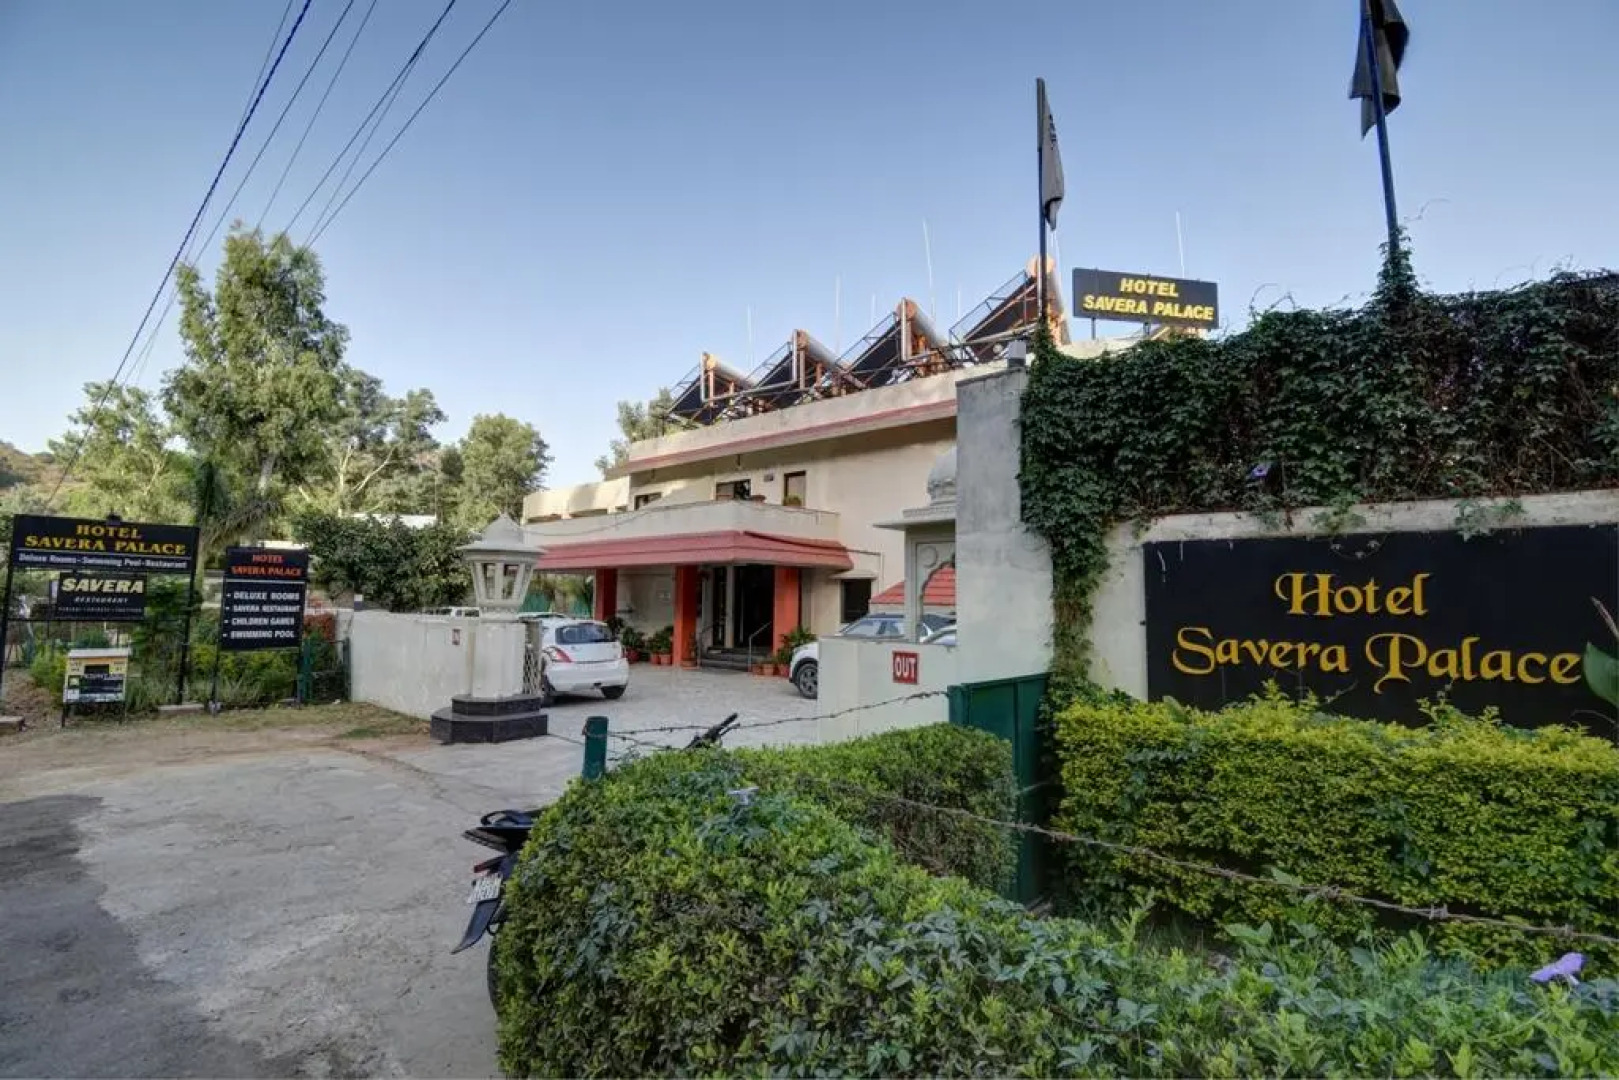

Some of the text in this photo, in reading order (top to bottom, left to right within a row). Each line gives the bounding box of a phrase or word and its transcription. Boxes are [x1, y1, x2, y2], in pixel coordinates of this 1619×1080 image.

[1120, 278, 1179, 297] HOTEL
[1083, 294, 1214, 320] SAVERA PALACE
[76, 524, 142, 539] HOTEL
[24, 535, 186, 556] SAVERA PALACE
[252, 554, 284, 564] HOTEL
[267, 567, 302, 577] PALACE
[62, 578, 144, 594] SAVERA
[233, 591, 300, 601] DELUXE ROOMS
[1275, 572, 1430, 617] Hotel
[233, 605, 260, 613] SAVERA
[231, 617, 295, 626] CHILDREN GAMES
[230, 630, 295, 639] SWIMMING POOL
[894, 656, 916, 678] OUT
[1172, 626, 1583, 695] Savera Palace
